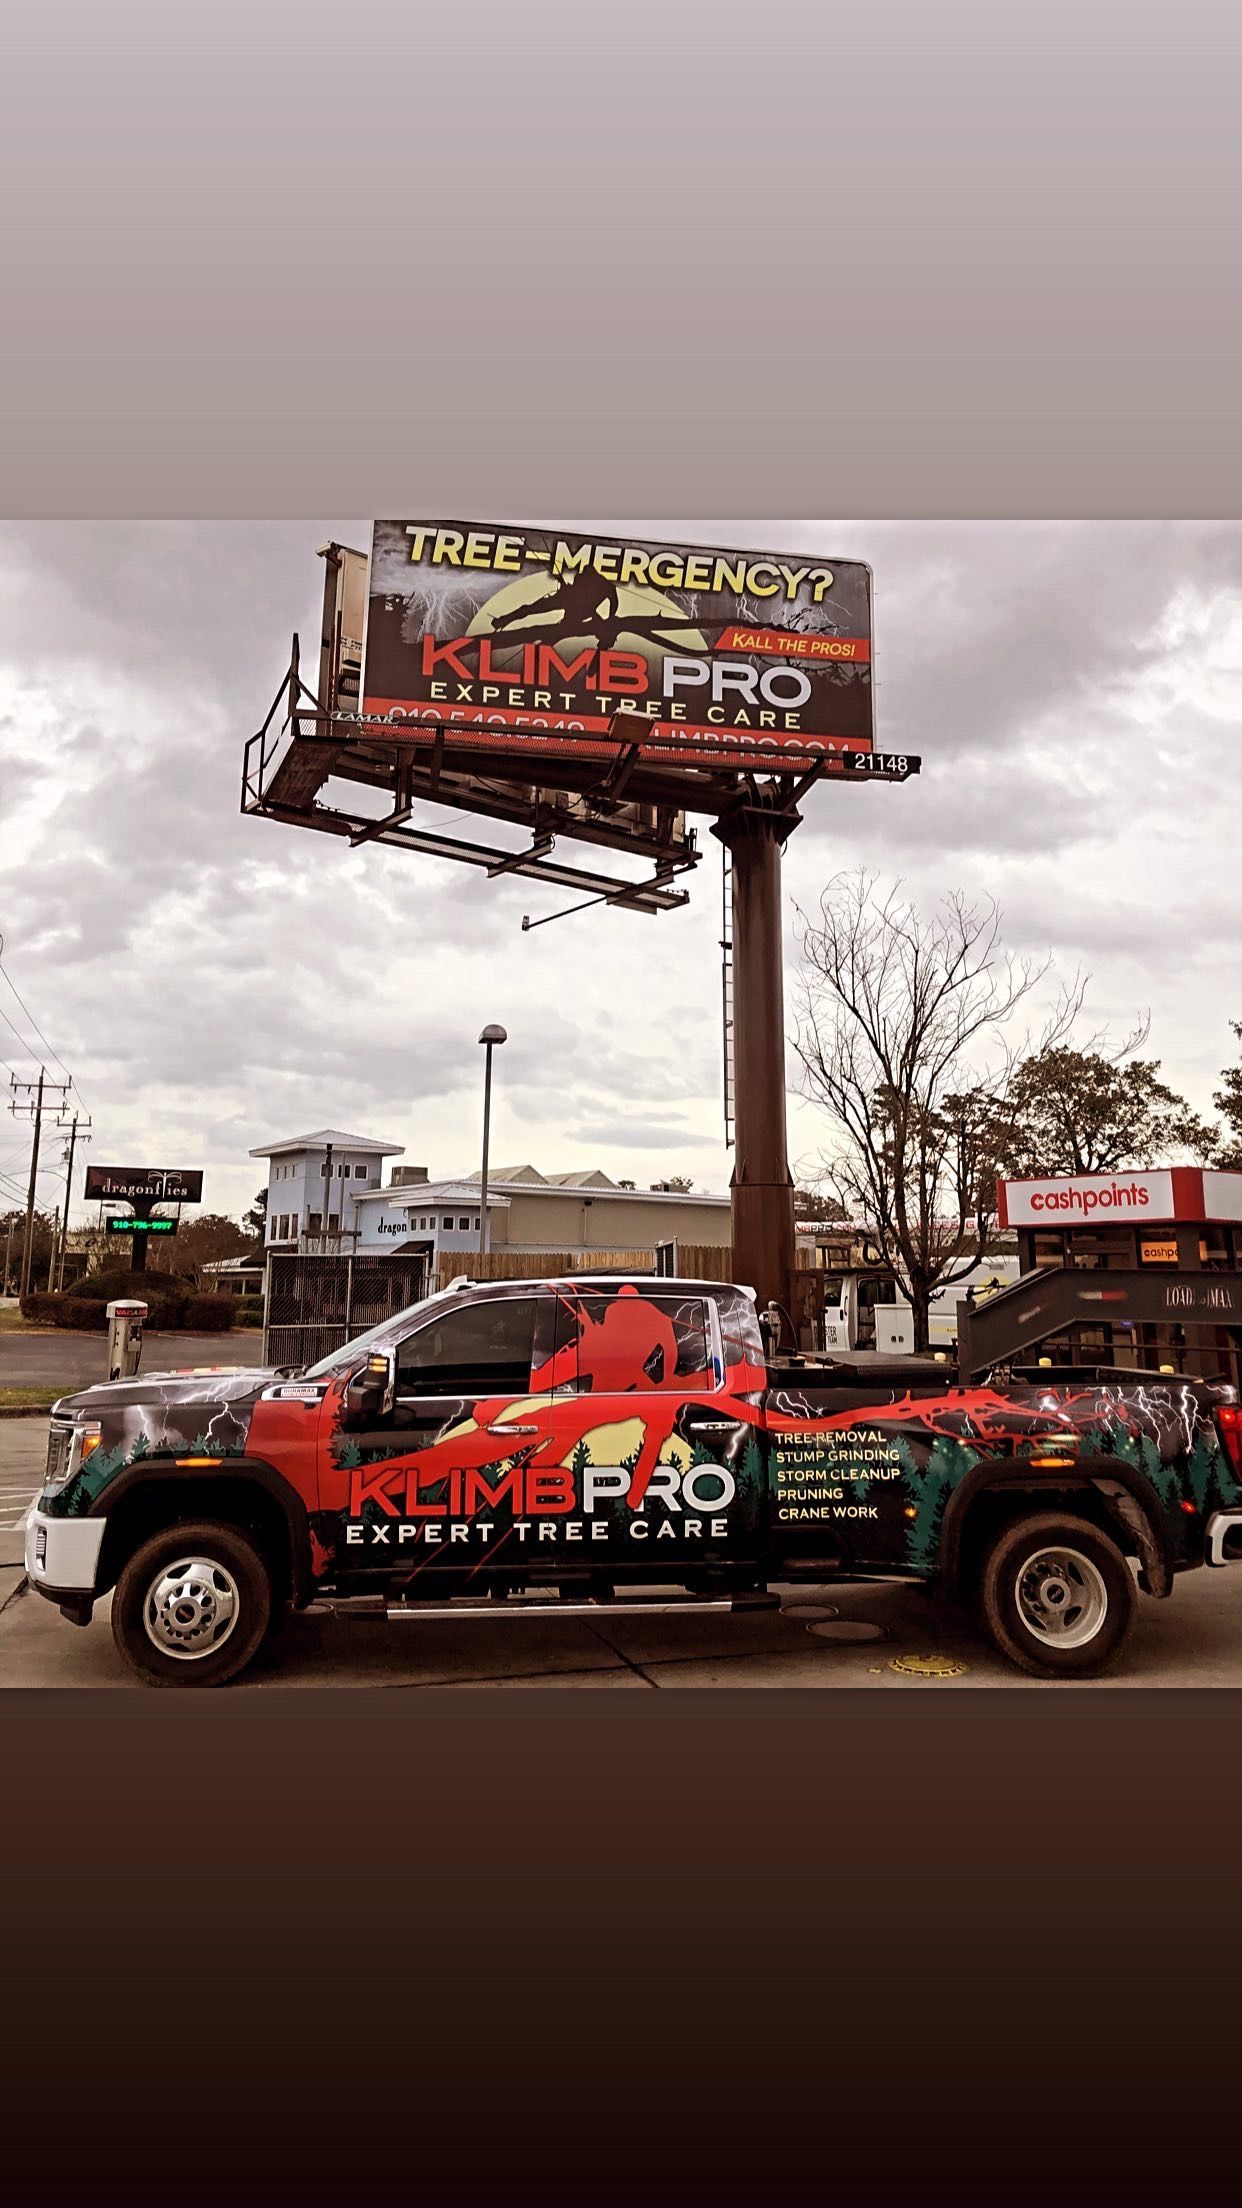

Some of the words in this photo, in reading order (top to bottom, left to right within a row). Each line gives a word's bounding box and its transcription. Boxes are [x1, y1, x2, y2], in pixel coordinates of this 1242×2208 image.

[405, 525, 834, 602] TREE-MERGENCY?
[732, 633, 773, 650] KALL
[777, 637, 807, 653] THE
[816, 641, 856, 657] PROS!
[422, 633, 649, 695] KLIMB
[662, 656, 812, 709] PRO
[430, 681, 577, 711] EXPERT
[595, 696, 687, 721] TREE
[707, 706, 801, 730] CARE
[333, 711, 395, 725] LAMAR
[855, 753, 909, 773] 21148
[1030, 1181, 1150, 1217] cashpoints
[775, 1432, 812, 1444] TREE
[816, 1430, 887, 1443] REMOVAL
[776, 1450, 825, 1463] STUMP
[828, 1449, 900, 1462] GRINDING
[777, 1469, 827, 1482] STORM
[830, 1468, 901, 1480] CLEANUP
[777, 1487, 843, 1501] PRUNING
[778, 1506, 830, 1520] CRANE
[833, 1506, 879, 1519] WORK
[346, 1522, 495, 1545] EXPERT
[513, 1520, 609, 1542] TREE
[628, 1518, 728, 1540] CARE
